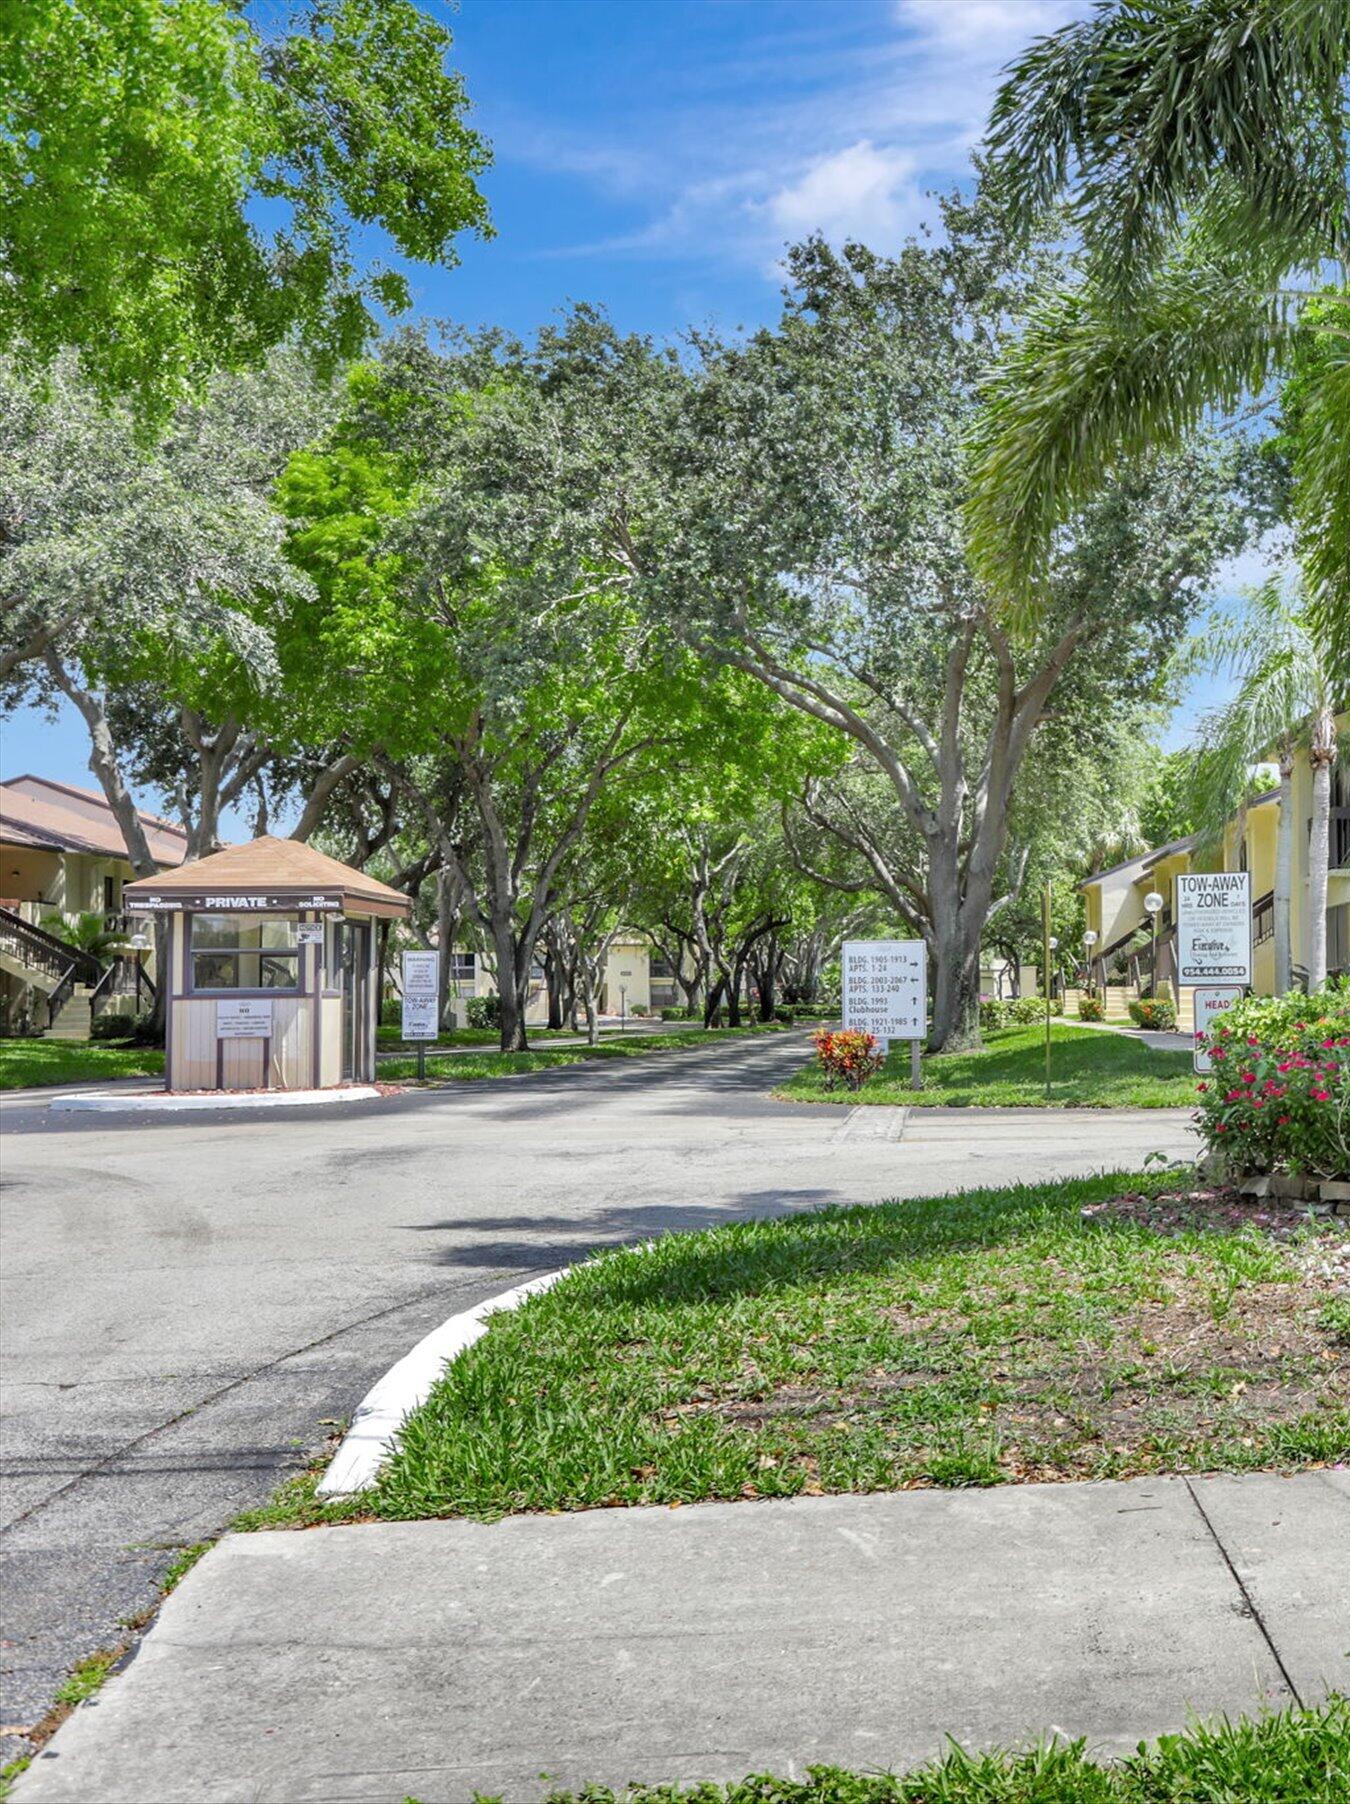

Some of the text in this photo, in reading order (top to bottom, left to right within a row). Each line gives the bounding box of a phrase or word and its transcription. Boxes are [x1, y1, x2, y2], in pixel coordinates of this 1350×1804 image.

[1181, 875, 1246, 892] TOW-AWAY
[205, 897, 267, 908] PRIVATE
[1197, 893, 1229, 908] ZONE
[849, 1006, 888, 1014] Clubhouse
[1205, 1000, 1230, 1009] HEAD
